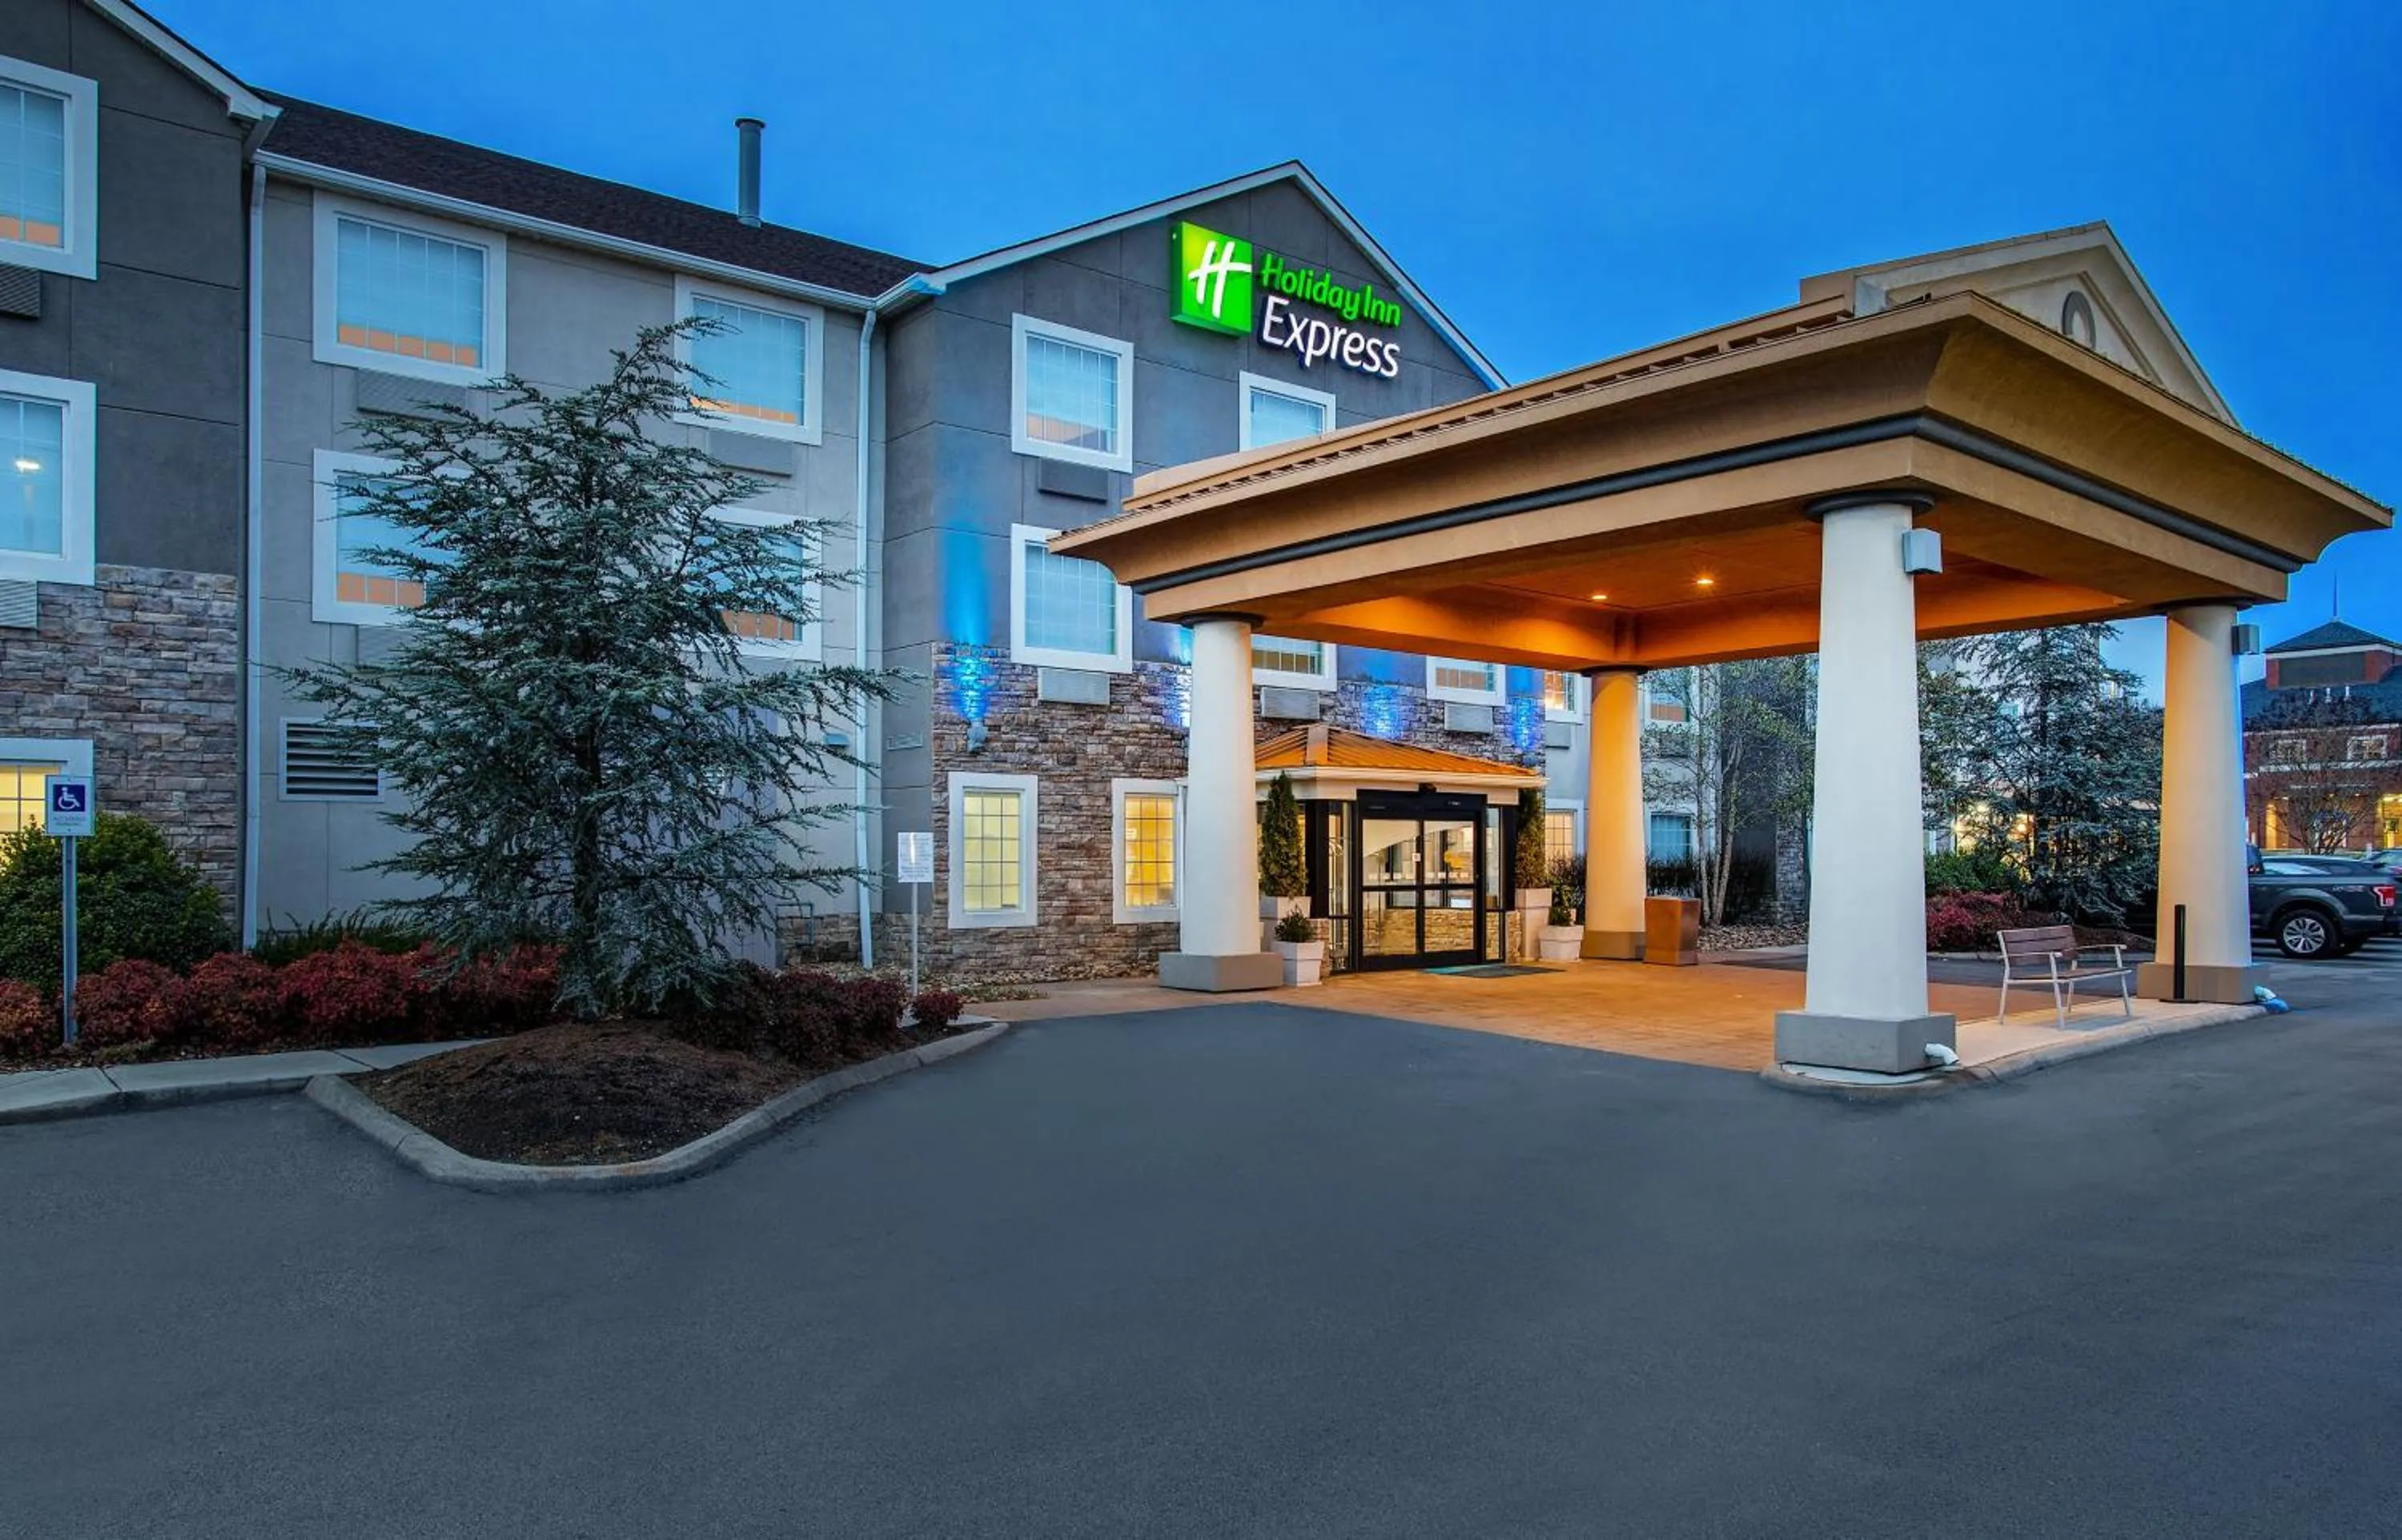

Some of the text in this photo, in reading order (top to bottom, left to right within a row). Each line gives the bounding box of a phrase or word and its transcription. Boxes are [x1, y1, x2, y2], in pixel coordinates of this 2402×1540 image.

[1188, 241, 1252, 319] H
[1261, 253, 1401, 327] Holiday Inn
[1262, 295, 1400, 378] Express
